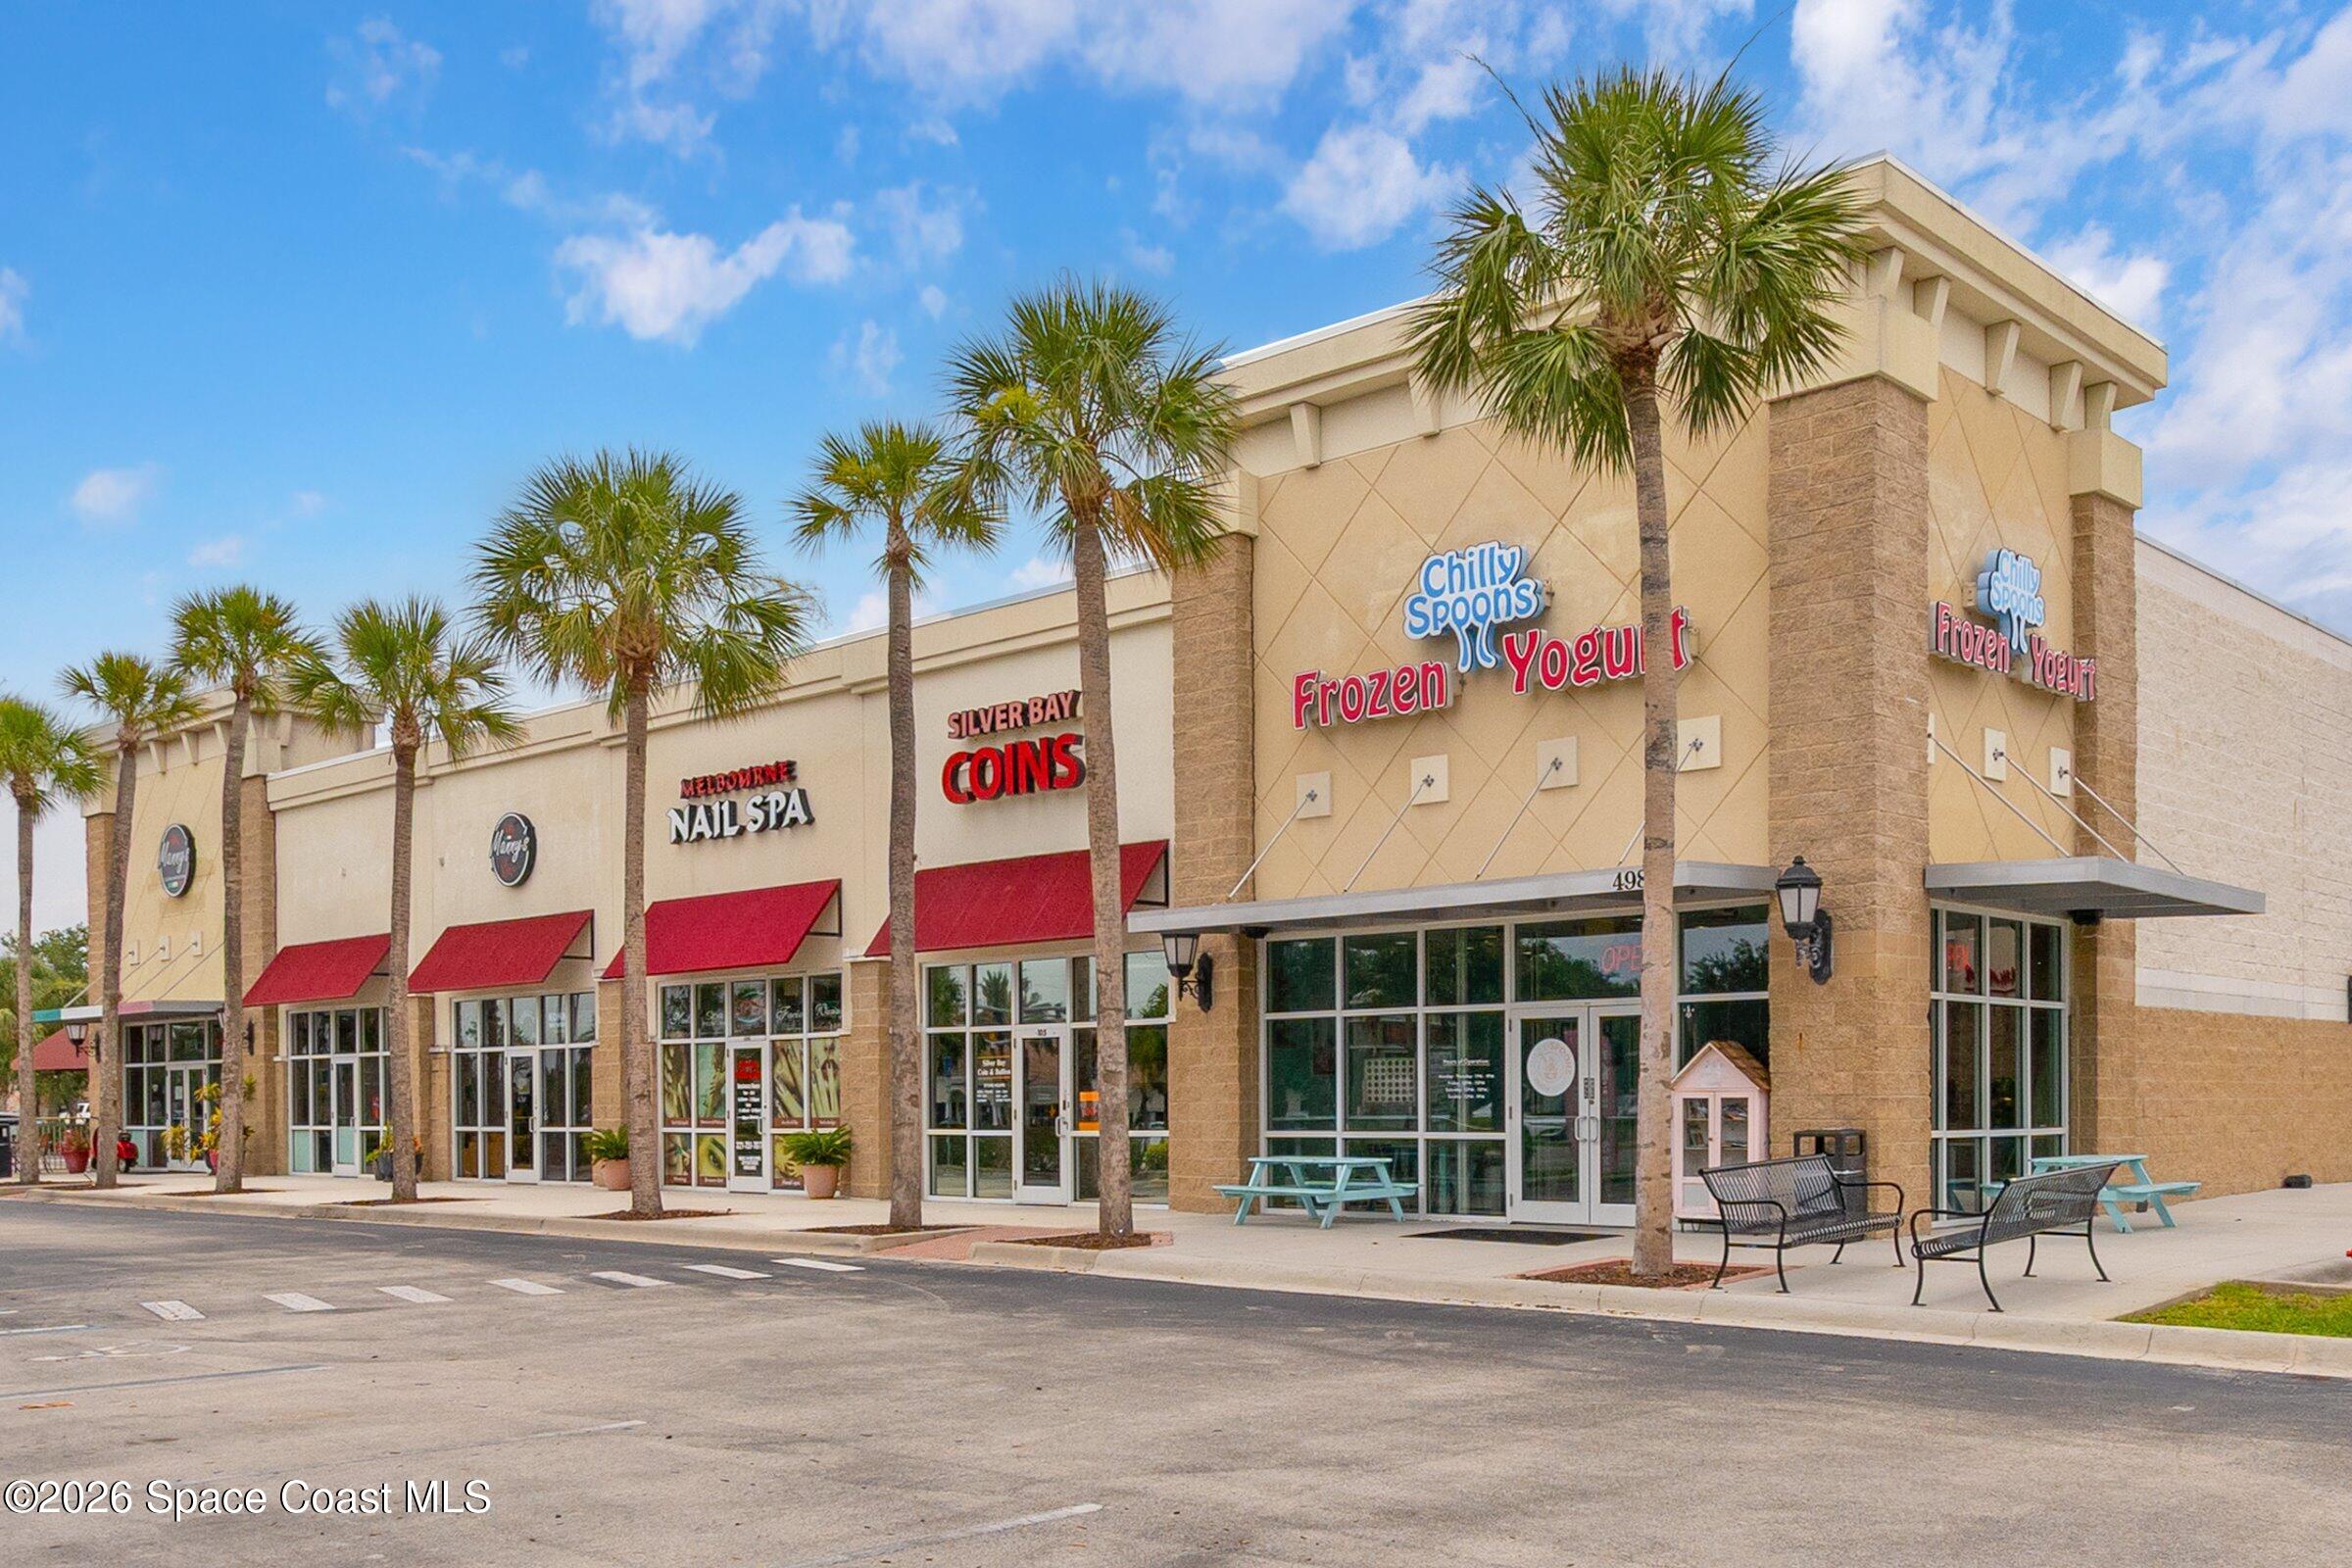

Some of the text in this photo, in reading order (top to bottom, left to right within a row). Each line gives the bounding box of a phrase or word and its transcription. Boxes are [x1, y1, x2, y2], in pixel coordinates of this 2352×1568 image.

[1423, 546, 1517, 598] Chilly
[1999, 549, 2039, 593] Chilly
[1408, 582, 1534, 651] Spoons
[1992, 574, 2044, 633] Spoons
[1503, 606, 1690, 694] Yogut
[1937, 602, 2009, 673] Frozen
[1293, 662, 1447, 729] Frozen
[2031, 634, 2095, 701] Yogurt
[948, 690, 1078, 739] SILVER BAY
[680, 760, 794, 799] MELBOURNE
[942, 733, 1083, 805] COINS
[666, 788, 811, 844] NAIL SPA
[1601, 944, 1643, 975] OPE
